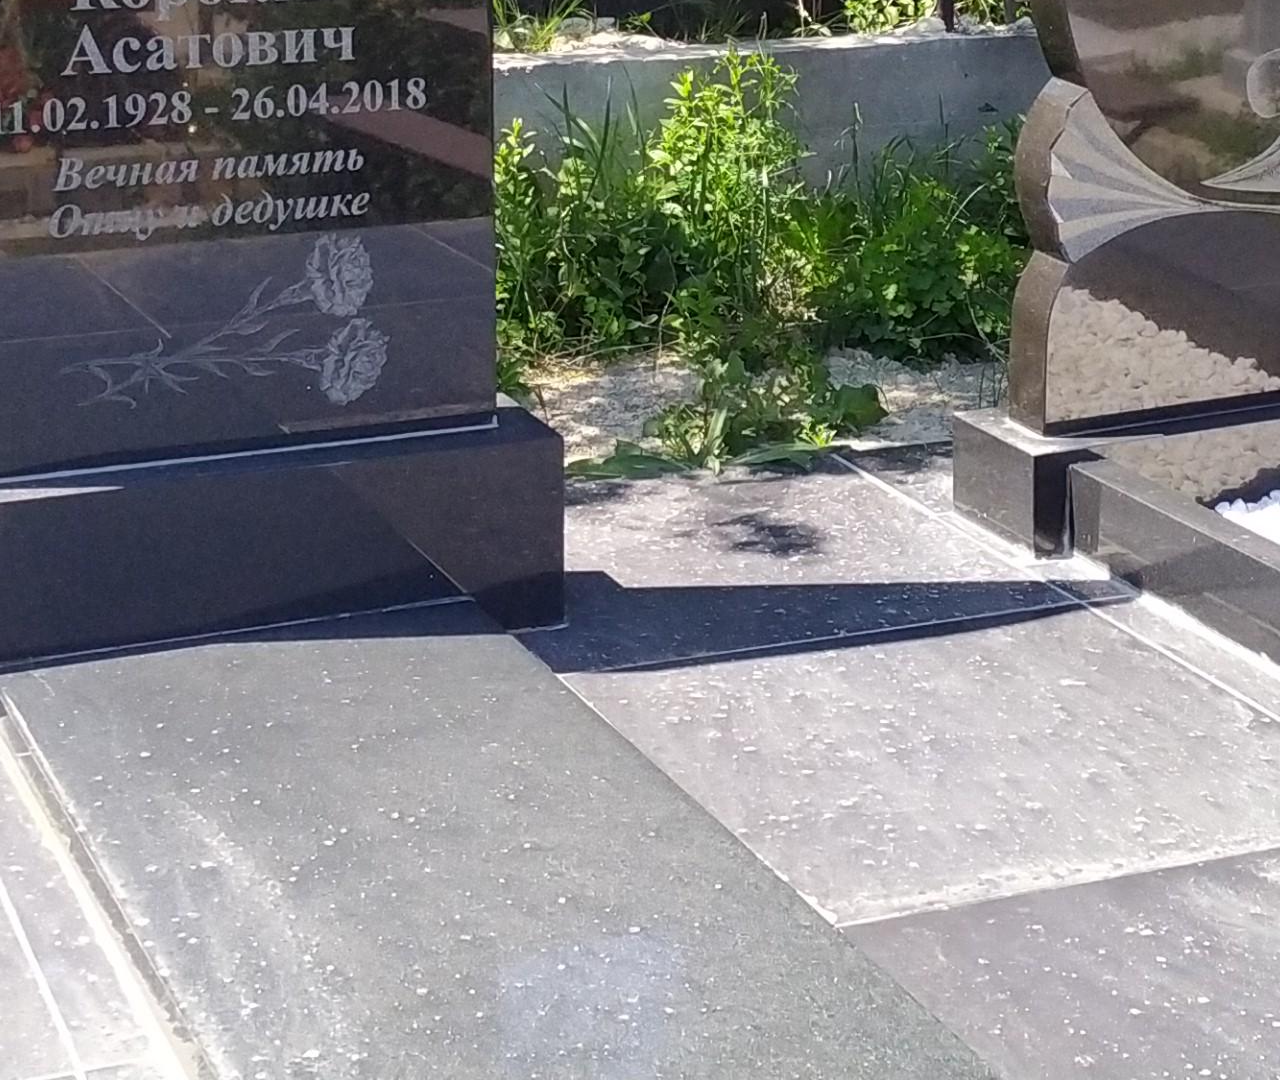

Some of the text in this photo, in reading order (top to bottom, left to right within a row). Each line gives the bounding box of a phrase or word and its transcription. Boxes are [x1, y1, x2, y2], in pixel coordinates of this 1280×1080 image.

[60, 23, 357, 76] Асатович
[231, 76, 429, 122] 26.04.2018
[52, 147, 366, 193] Вечная память
[211, 189, 371, 232] дедушке
